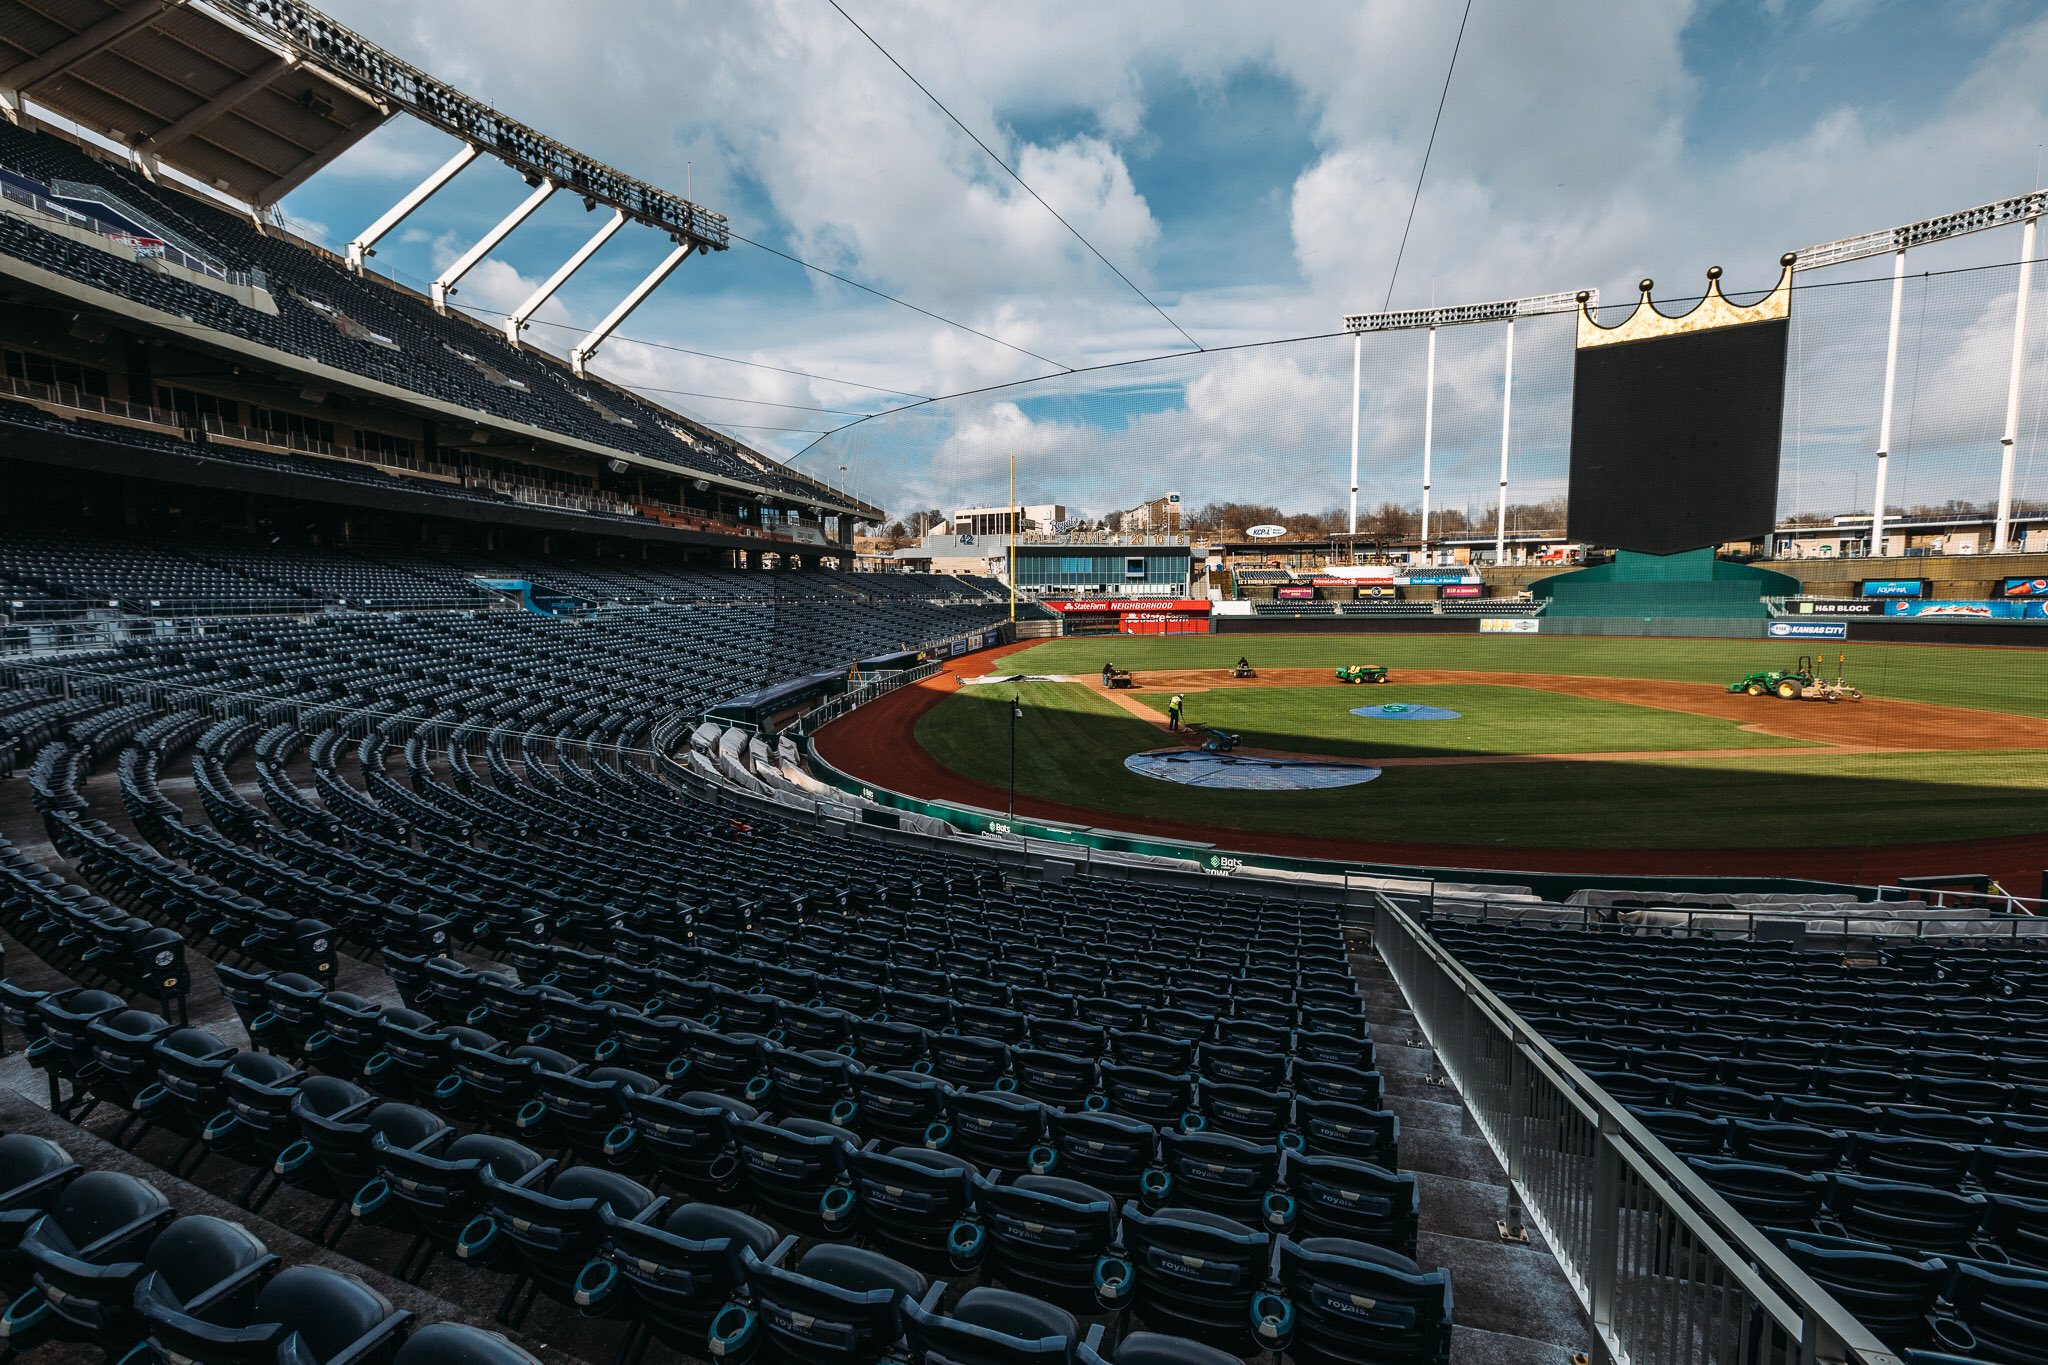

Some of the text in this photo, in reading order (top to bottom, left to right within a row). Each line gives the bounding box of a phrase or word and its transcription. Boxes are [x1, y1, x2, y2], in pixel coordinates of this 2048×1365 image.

[1050, 516, 1080, 533] Royals
[959, 534, 974, 545] 42
[1022, 532, 1057, 544] HALL
[1071, 531, 1107, 543] FAME
[1130, 534, 1145, 545] 20
[1153, 534, 1165, 545] 10
[1176, 534, 1184, 545] 5
[1323, 1194, 1355, 1207] royals.
[1161, 1260, 1199, 1275] royals.
[1328, 1299, 1370, 1317] royals.
